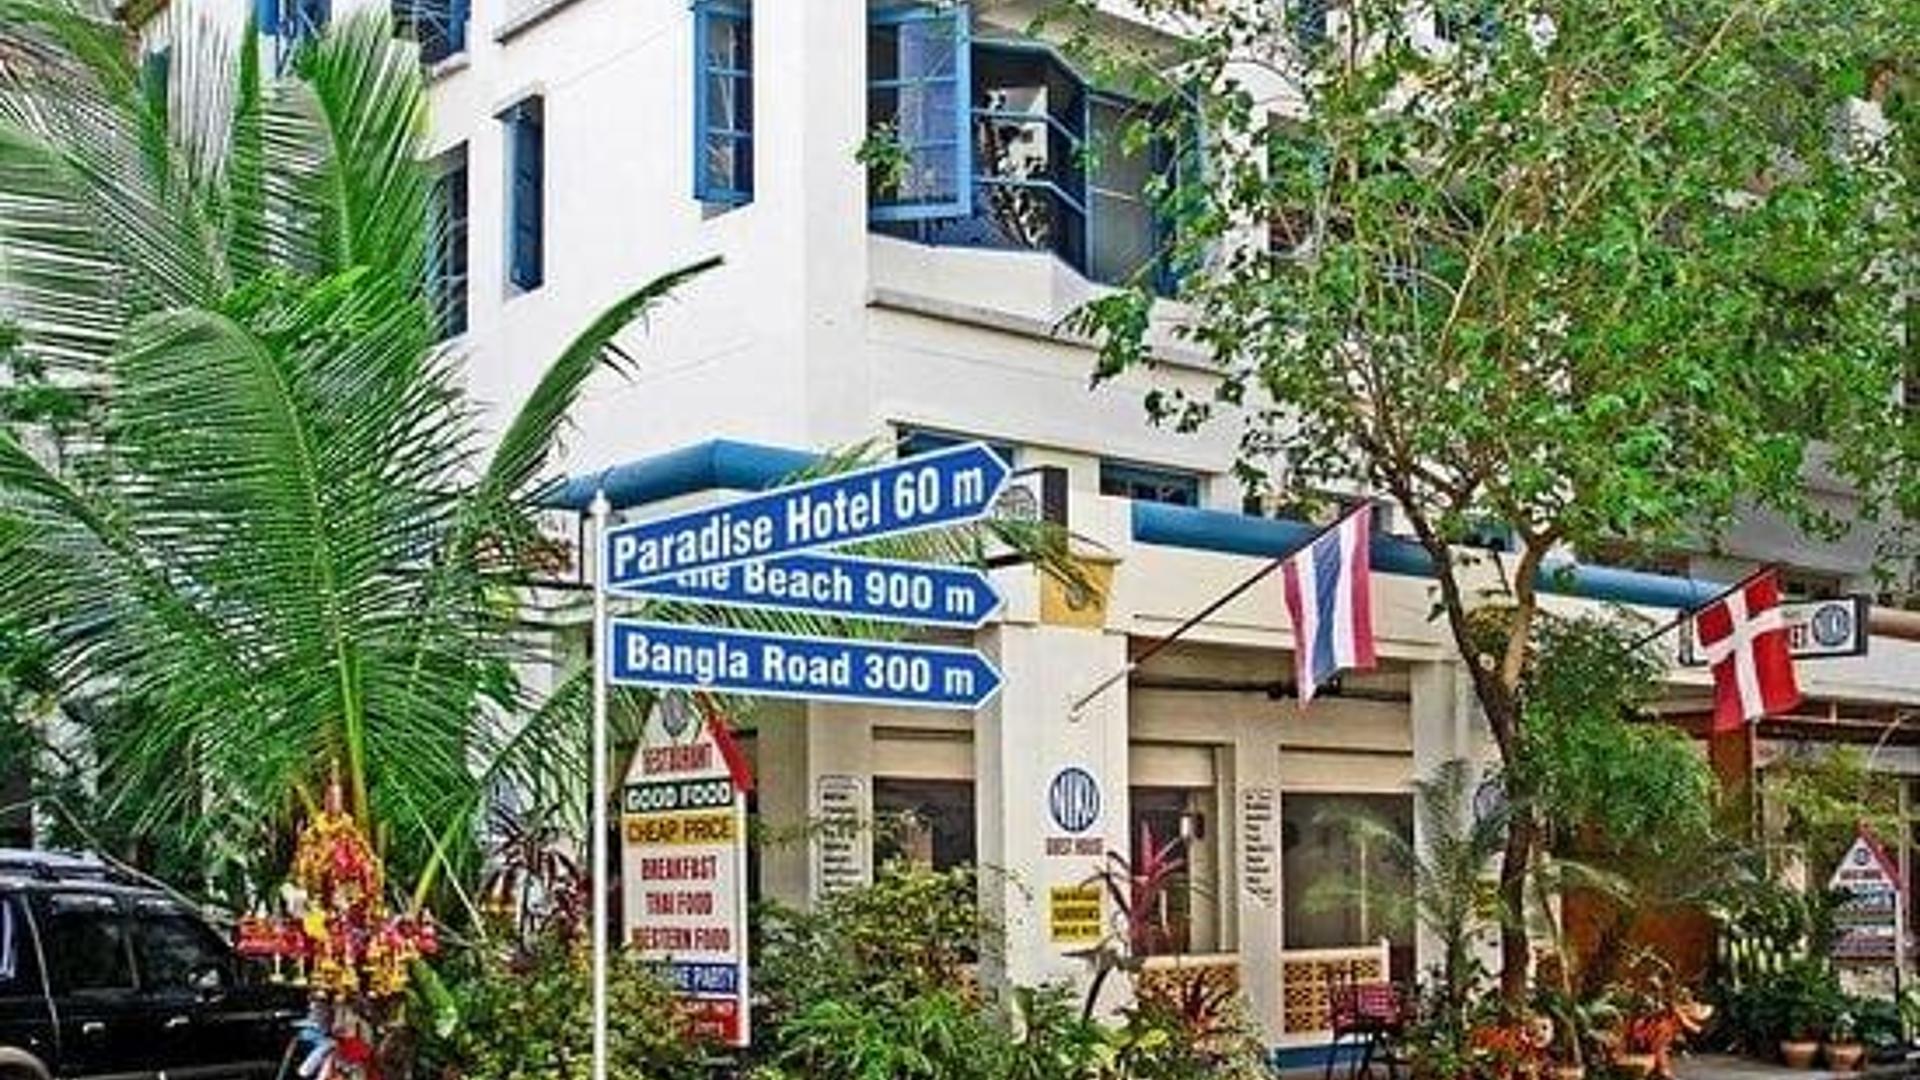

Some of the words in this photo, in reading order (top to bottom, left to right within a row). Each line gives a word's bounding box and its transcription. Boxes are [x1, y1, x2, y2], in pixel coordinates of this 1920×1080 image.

[614, 515, 773, 577] Paradise
[787, 482, 881, 543] Hotel
[894, 467, 939, 519] 60
[953, 467, 983, 504] m
[743, 561, 853, 603] Beach
[865, 573, 933, 609] 900
[945, 586, 976, 615] m
[626, 634, 749, 683] Bangla
[763, 647, 850, 688] Road
[865, 657, 930, 693] 300
[945, 667, 975, 696] m
[628, 785, 678, 811] GOOD
[681, 781, 731, 807] FOOD
[628, 818, 678, 843] CHEAP
[684, 816, 733, 842] PRICE
[642, 856, 717, 881] BREAKFAST
[646, 891, 674, 915] THAI
[677, 891, 713, 915] FOOD
[695, 927, 730, 951] FOOD
